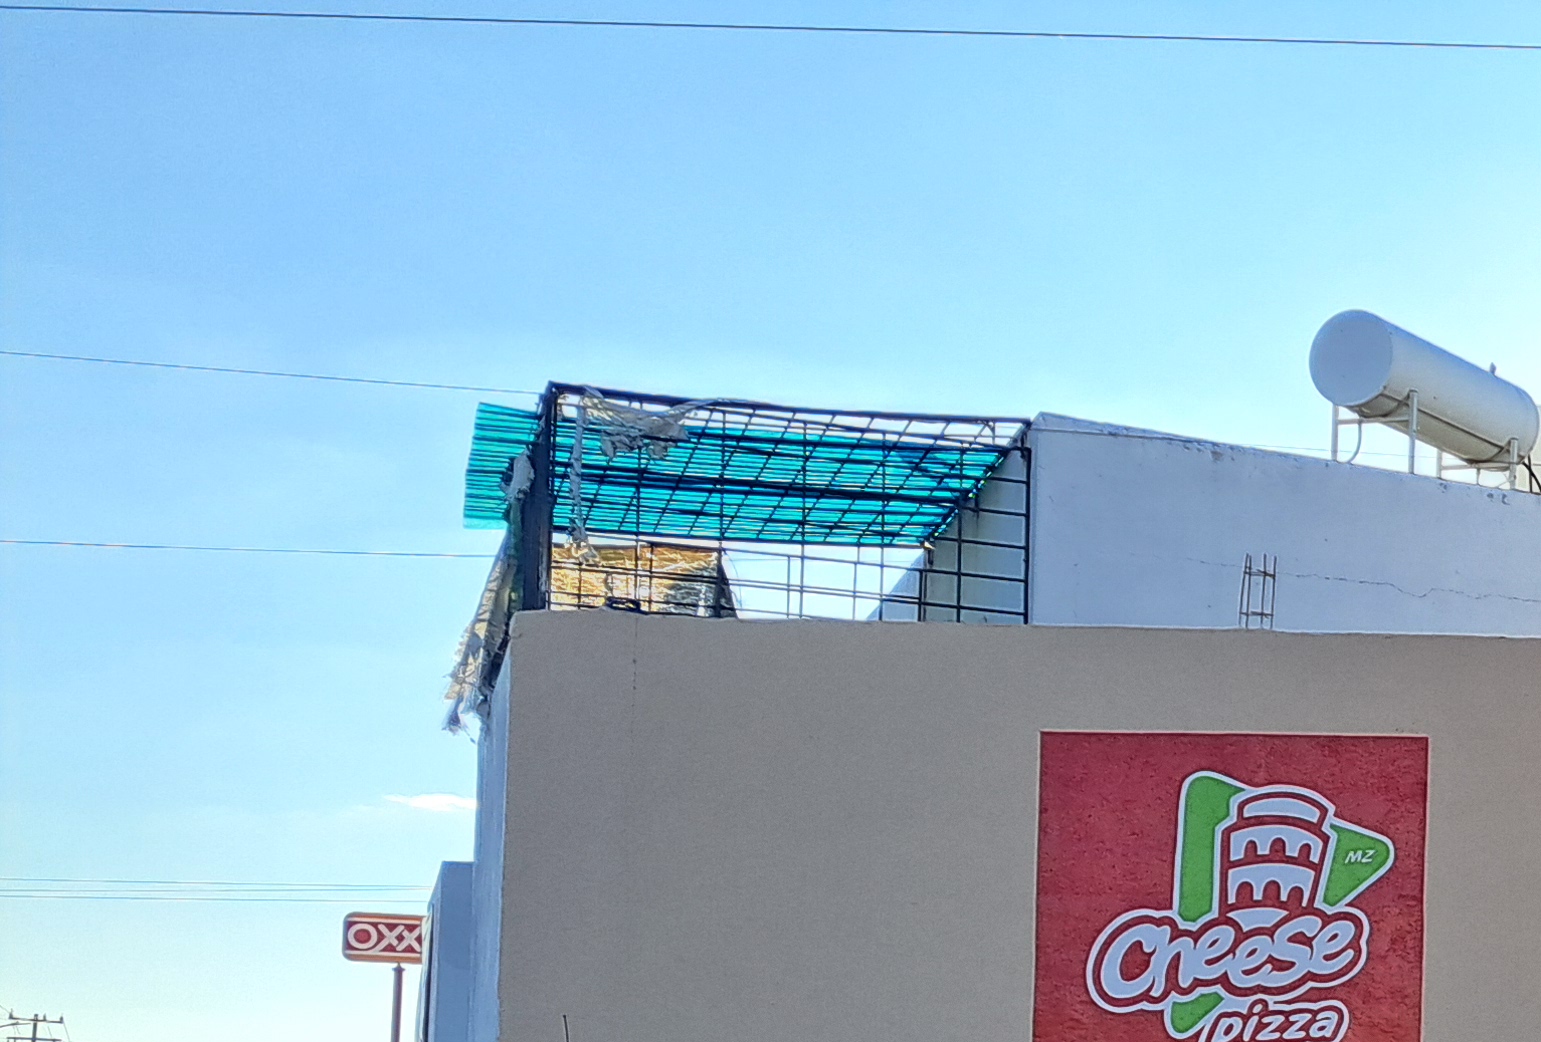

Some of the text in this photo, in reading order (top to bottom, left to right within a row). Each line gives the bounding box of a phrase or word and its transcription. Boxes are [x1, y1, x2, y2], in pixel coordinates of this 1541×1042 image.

[1344, 849, 1376, 865] MZ
[347, 922, 422, 953] OXX
[1100, 914, 1356, 999] Cheese
